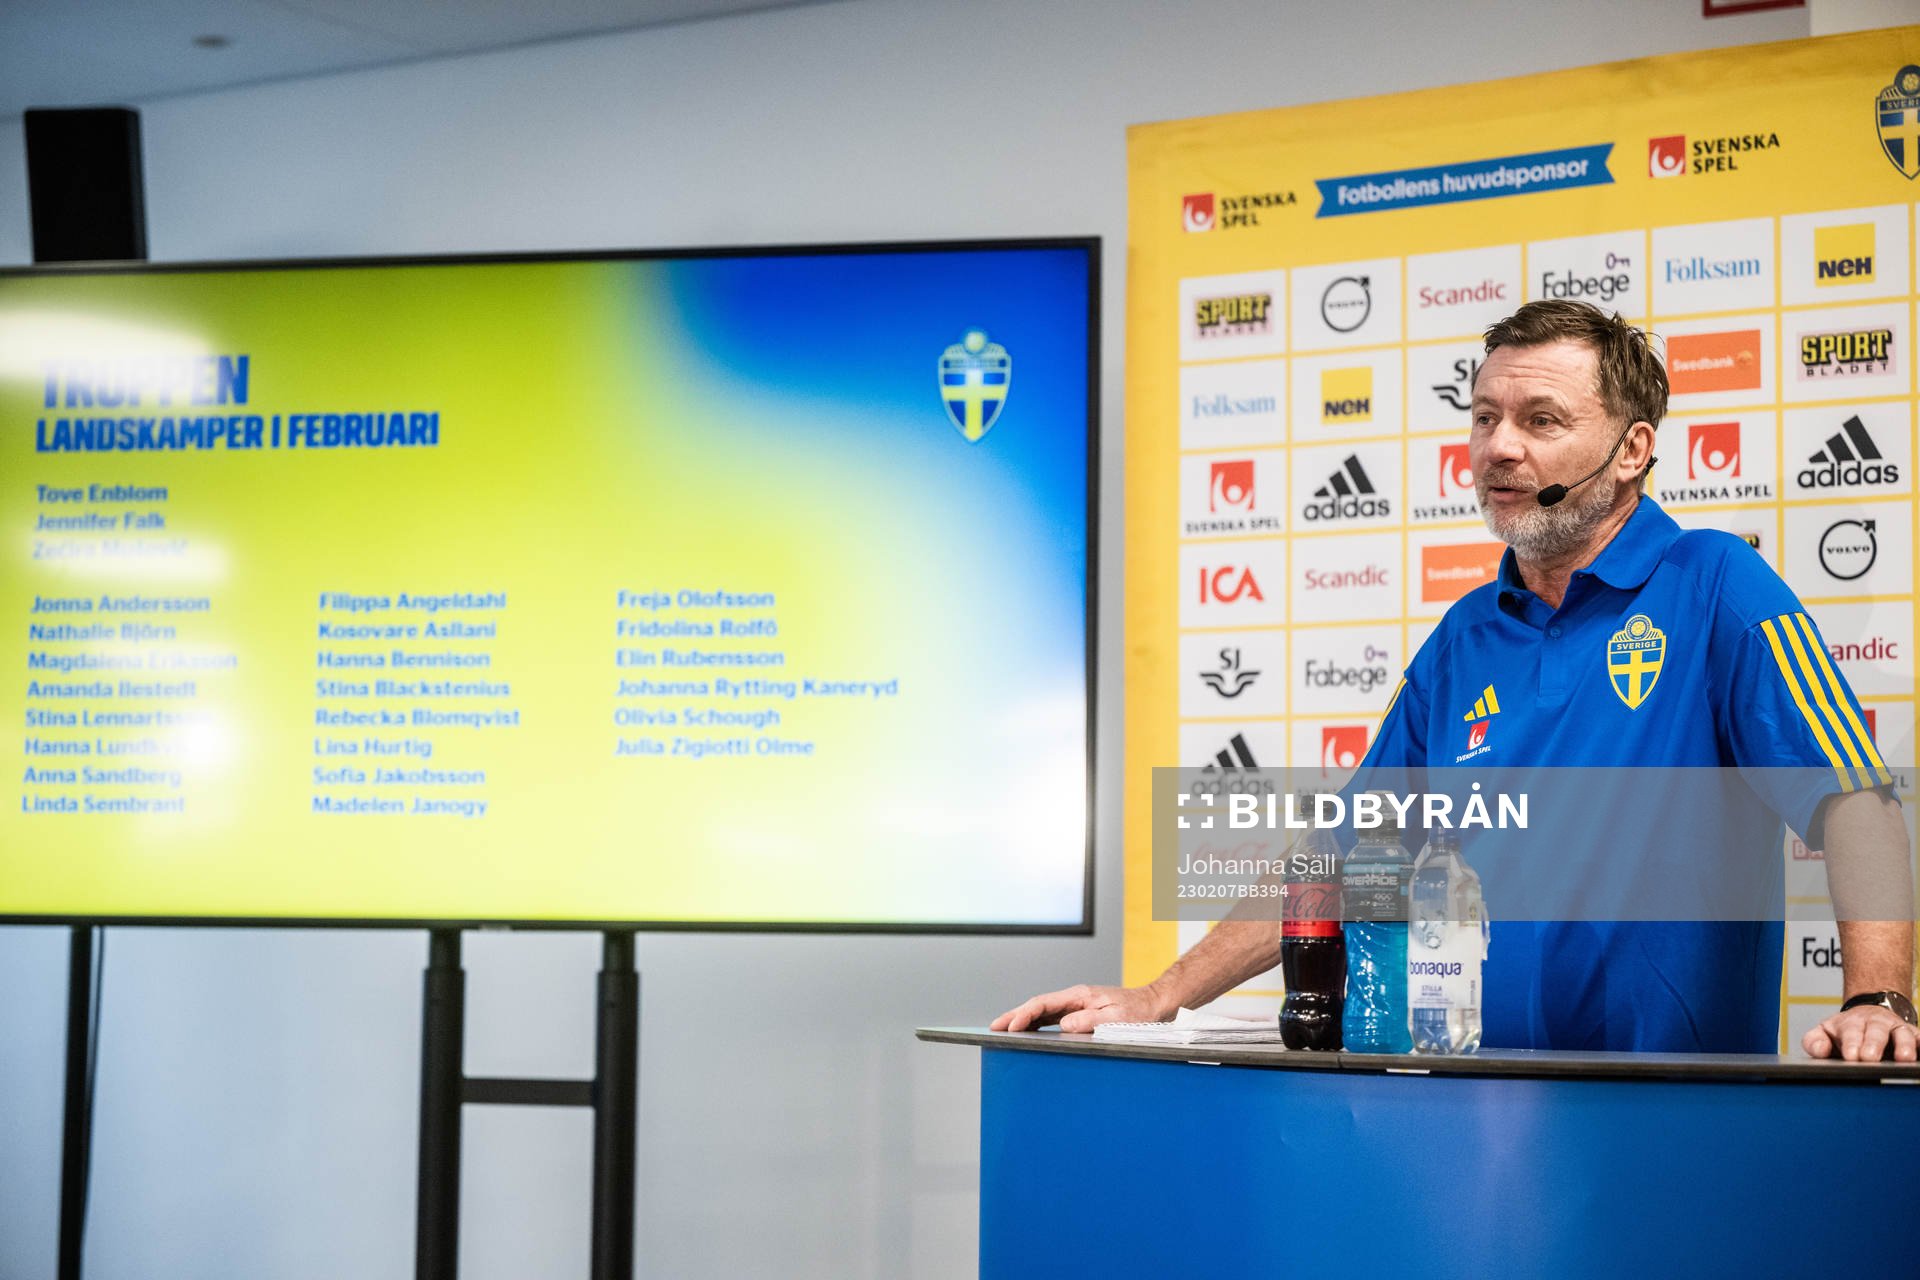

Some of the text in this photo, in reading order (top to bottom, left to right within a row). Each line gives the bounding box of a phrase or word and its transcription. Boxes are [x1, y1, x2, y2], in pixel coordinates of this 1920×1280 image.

[1693, 132, 1780, 157] SVENSKA
[1693, 155, 1738, 175] SPEL
[1337, 159, 1589, 206] Fotbollens huvudsponsor
[1221, 191, 1297, 213] SVENSKA
[1222, 212, 1259, 229] SPEL
[1665, 257, 1761, 284] Folksam
[1419, 281, 1506, 309] Scandic
[1543, 270, 1630, 301] Fabege
[1196, 294, 1271, 328] SPORT
[1801, 329, 1892, 367] SPORT
[1672, 356, 1735, 373] Swedbank
[1806, 361, 1888, 377] BLADET
[1192, 393, 1277, 418] Folksam
[36, 412, 440, 453] LANDSKAMPER I FEBRUARI
[1796, 461, 1899, 489] adidas
[37, 484, 168, 502] Tove Enblom
[1660, 484, 1772, 502] SVENSKA SPEL
[1303, 496, 1391, 521] adidas
[1413, 504, 1477, 519] SVENSKA
[35, 511, 165, 531] Jennifer Falk
[1185, 517, 1281, 534] SVENSKA SPEL
[1826, 546, 1870, 554] VOLVO
[1200, 566, 1264, 604] ICA
[1304, 565, 1388, 590] Scandic
[31, 595, 210, 613] Jonna Andersson
[29, 624, 115, 641] Nathalie
[1617, 641, 1657, 651] SVERIGE
[1830, 637, 1898, 661] andic
[317, 652, 385, 668] Hanna
[1220, 648, 1241, 671] SJ
[1305, 660, 1387, 693] Fabege
[27, 681, 113, 698] Amanda
[316, 680, 370, 697] Stina
[26, 709, 200, 727] Stina Lennarts
[25, 739, 90, 756] Hanna
[23, 767, 76, 784] Anna
[22, 795, 78, 813] Linda
[1802, 937, 1843, 968] Fab
